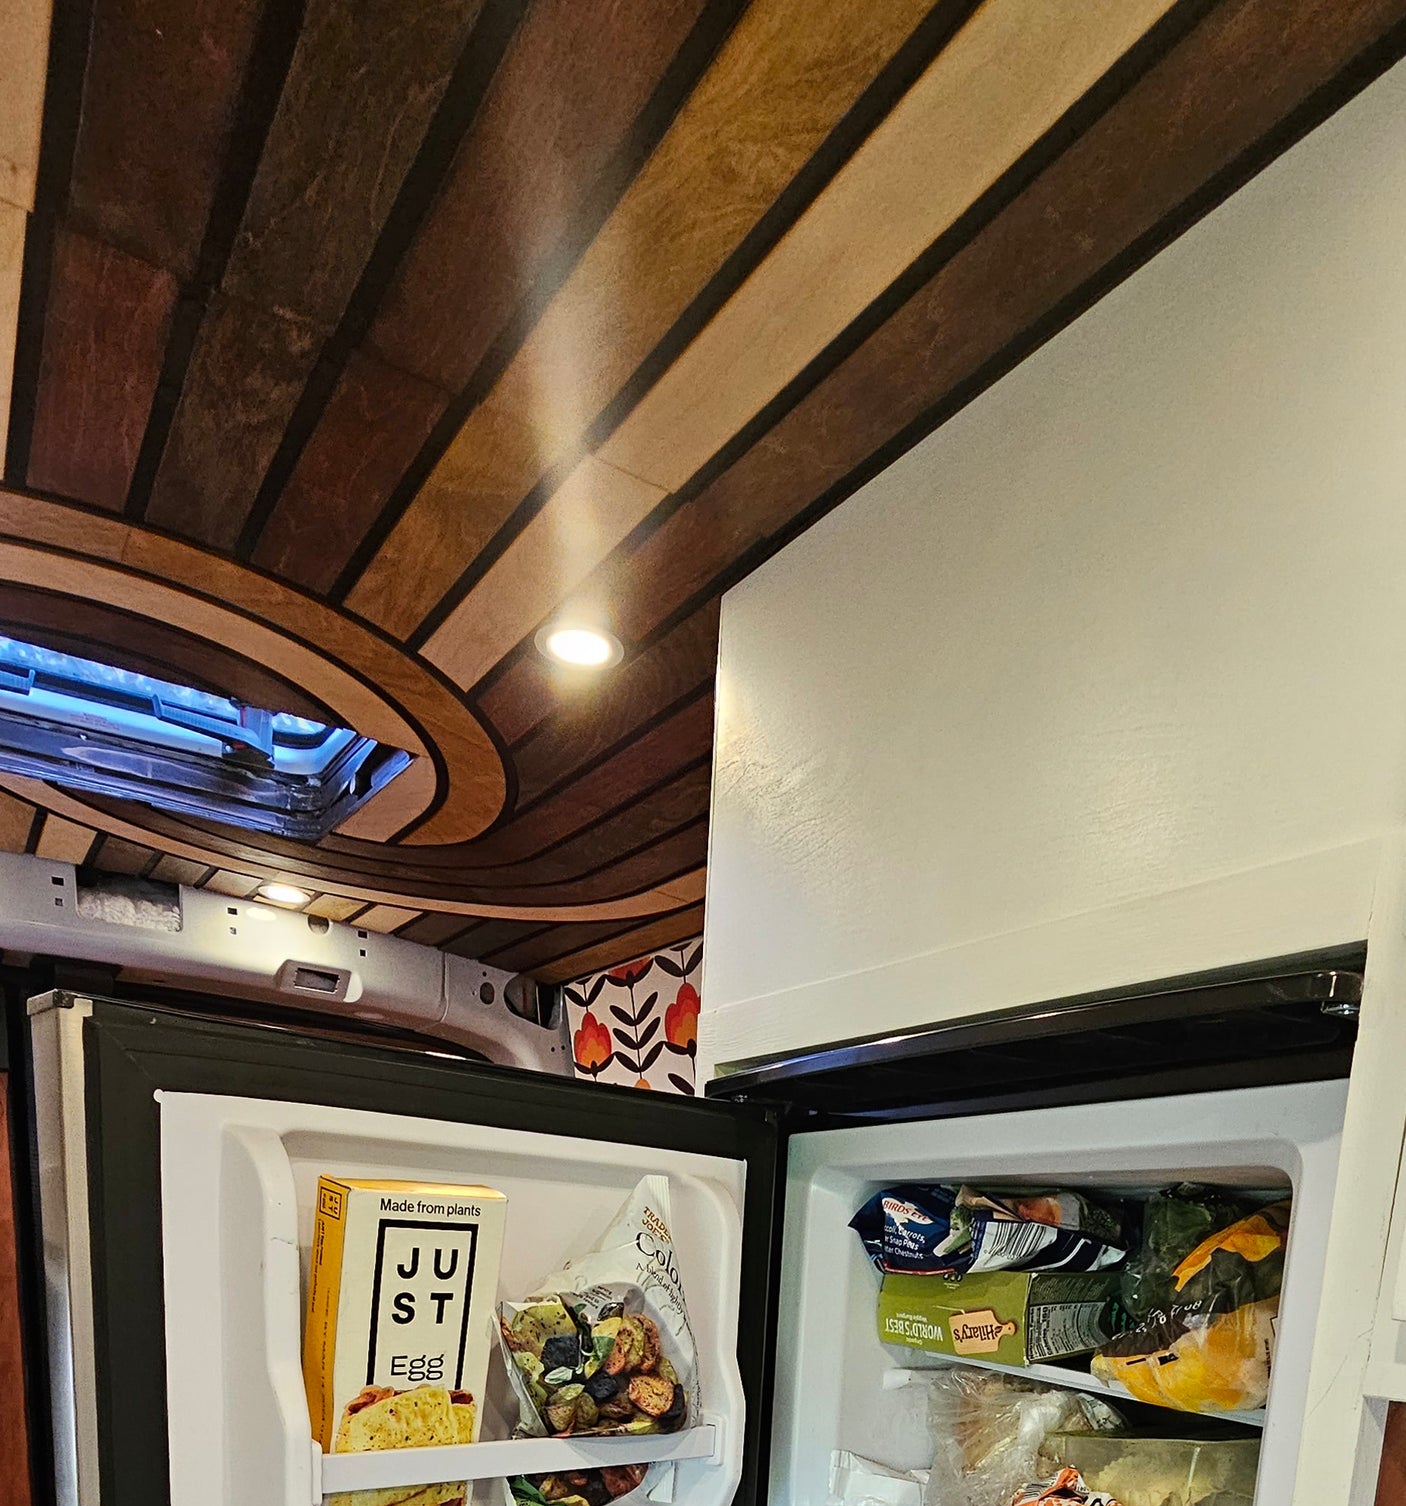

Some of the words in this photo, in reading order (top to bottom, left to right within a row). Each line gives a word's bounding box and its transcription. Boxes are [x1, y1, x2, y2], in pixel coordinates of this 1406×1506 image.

[380, 1198, 415, 1213] Made
[417, 1200, 445, 1215] from
[446, 1203, 481, 1218] plants
[884, 1200, 910, 1215] BIRDS
[903, 1239, 919, 1251] Peas
[885, 1317, 905, 1335] BEST
[904, 1320, 944, 1342] WORLD'S
[953, 1323, 996, 1343] Hilary's
[390, 1353, 445, 1382] Egg
